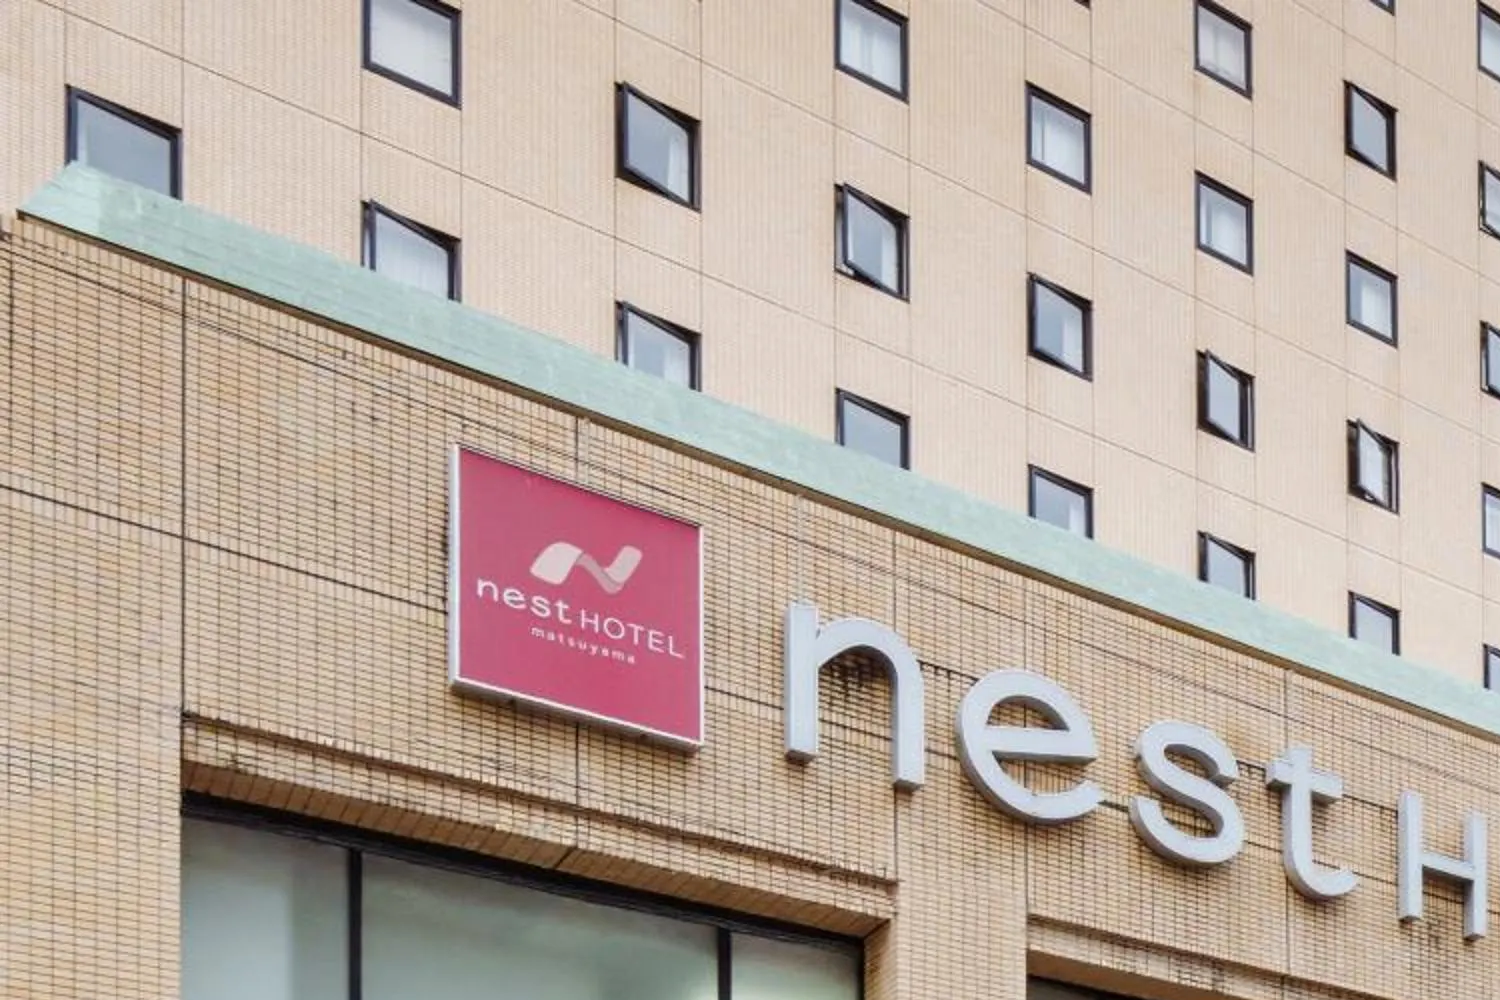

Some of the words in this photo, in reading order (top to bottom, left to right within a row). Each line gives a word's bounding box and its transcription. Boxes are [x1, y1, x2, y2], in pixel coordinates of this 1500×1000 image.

[476, 577, 573, 625] nest
[580, 609, 685, 659] HOTEL
[530, 626, 636, 664] matsuyama
[784, 600, 1359, 901] nest
